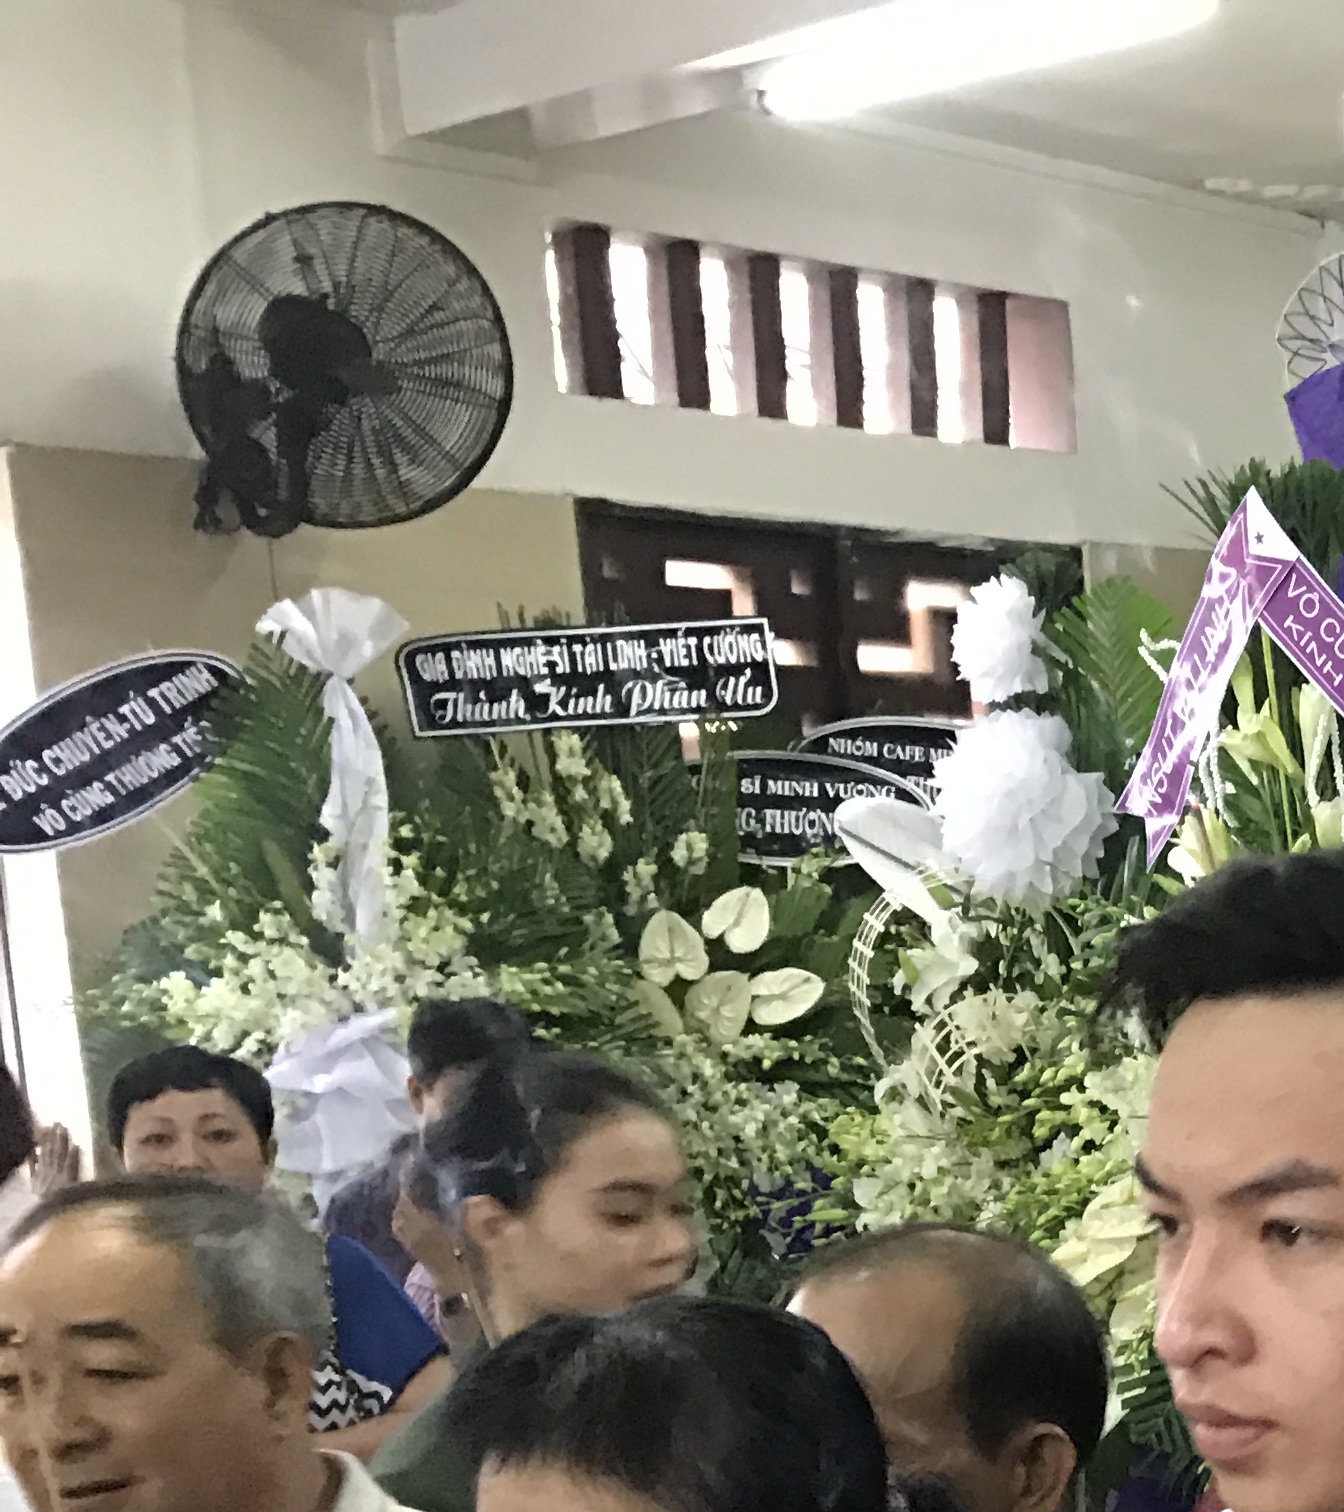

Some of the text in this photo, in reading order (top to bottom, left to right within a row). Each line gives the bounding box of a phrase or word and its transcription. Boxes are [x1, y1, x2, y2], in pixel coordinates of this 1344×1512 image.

[1287, 573, 1319, 618] VÔ
[415, 652, 449, 683] GIA
[451, 642, 498, 680] ĐÌNH
[572, 636, 604, 675] TÀI
[607, 638, 648, 671] LINH
[659, 626, 698, 667] VIẾT
[703, 626, 764, 665] CƯỜNG
[1284, 615, 1343, 687] KÍNH
[430, 667, 766, 724] Thành Kính Phân Ưu
[828, 736, 878, 757] NHÓM
[32, 803, 66, 836] VÔ
[61, 781, 115, 822] CÙNG
[104, 743, 182, 796] THƯƠNG
[766, 779, 819, 797] MINH
[824, 781, 896, 800] VƯƠNG
[763, 807, 836, 836] THƯƠN
